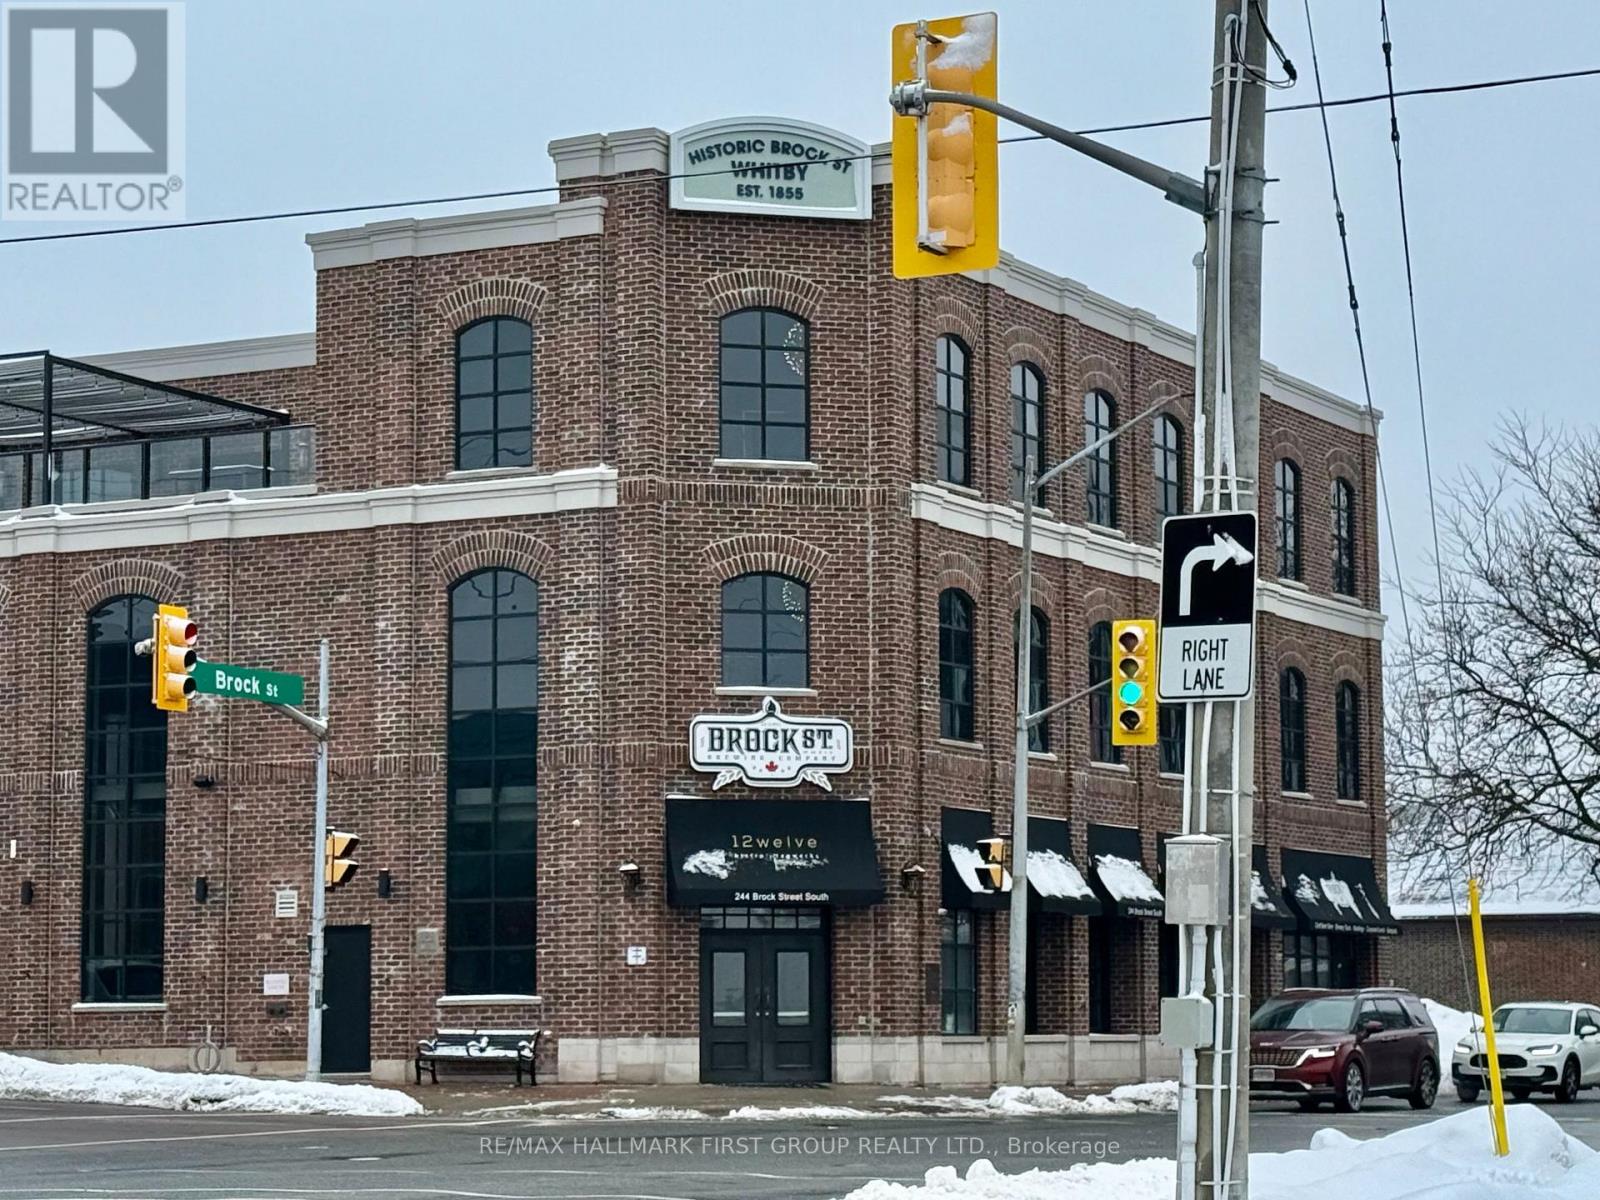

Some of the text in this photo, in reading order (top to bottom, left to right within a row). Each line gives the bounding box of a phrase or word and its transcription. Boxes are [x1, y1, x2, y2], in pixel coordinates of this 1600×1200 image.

[688, 139, 766, 166] HISTORIC
[770, 140, 830, 165] BROCK
[730, 160, 808, 181] WHITBY
[736, 184, 804, 200] EST. 1855
[1182, 638, 1229, 662] RIGHT
[215, 669, 279, 698] Brock St
[1183, 667, 1225, 691] LANE
[707, 727, 801, 756] BROCK
[731, 834, 818, 848] 12welve
[734, 891, 830, 901] 244 Brock Street South
